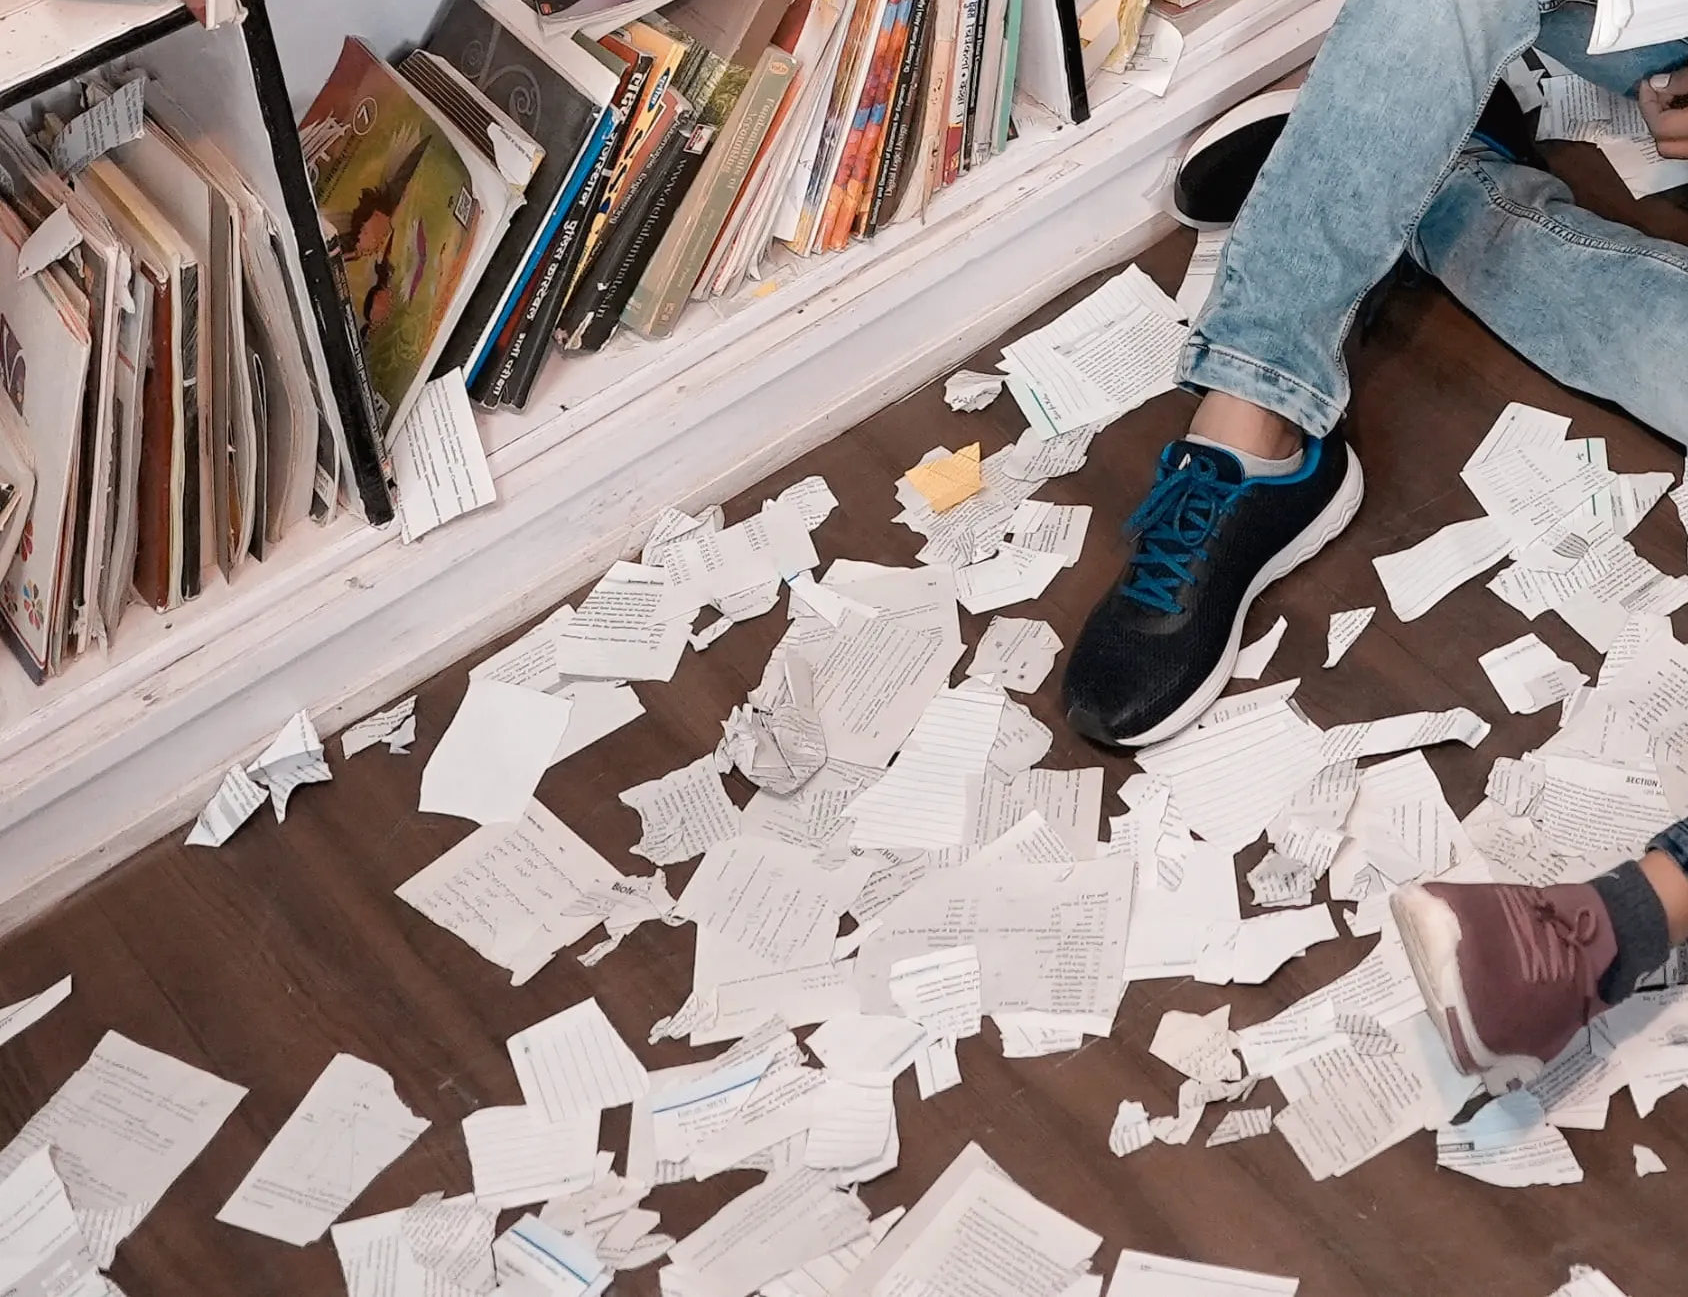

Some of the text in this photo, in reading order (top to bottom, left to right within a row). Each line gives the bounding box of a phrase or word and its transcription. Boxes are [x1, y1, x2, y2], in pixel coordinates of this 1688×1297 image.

[731, 95, 776, 178] Fundamentals
[490, 216, 579, 396] पुलिस परीक्षा
[1625, 775, 1659, 789] SECTION
